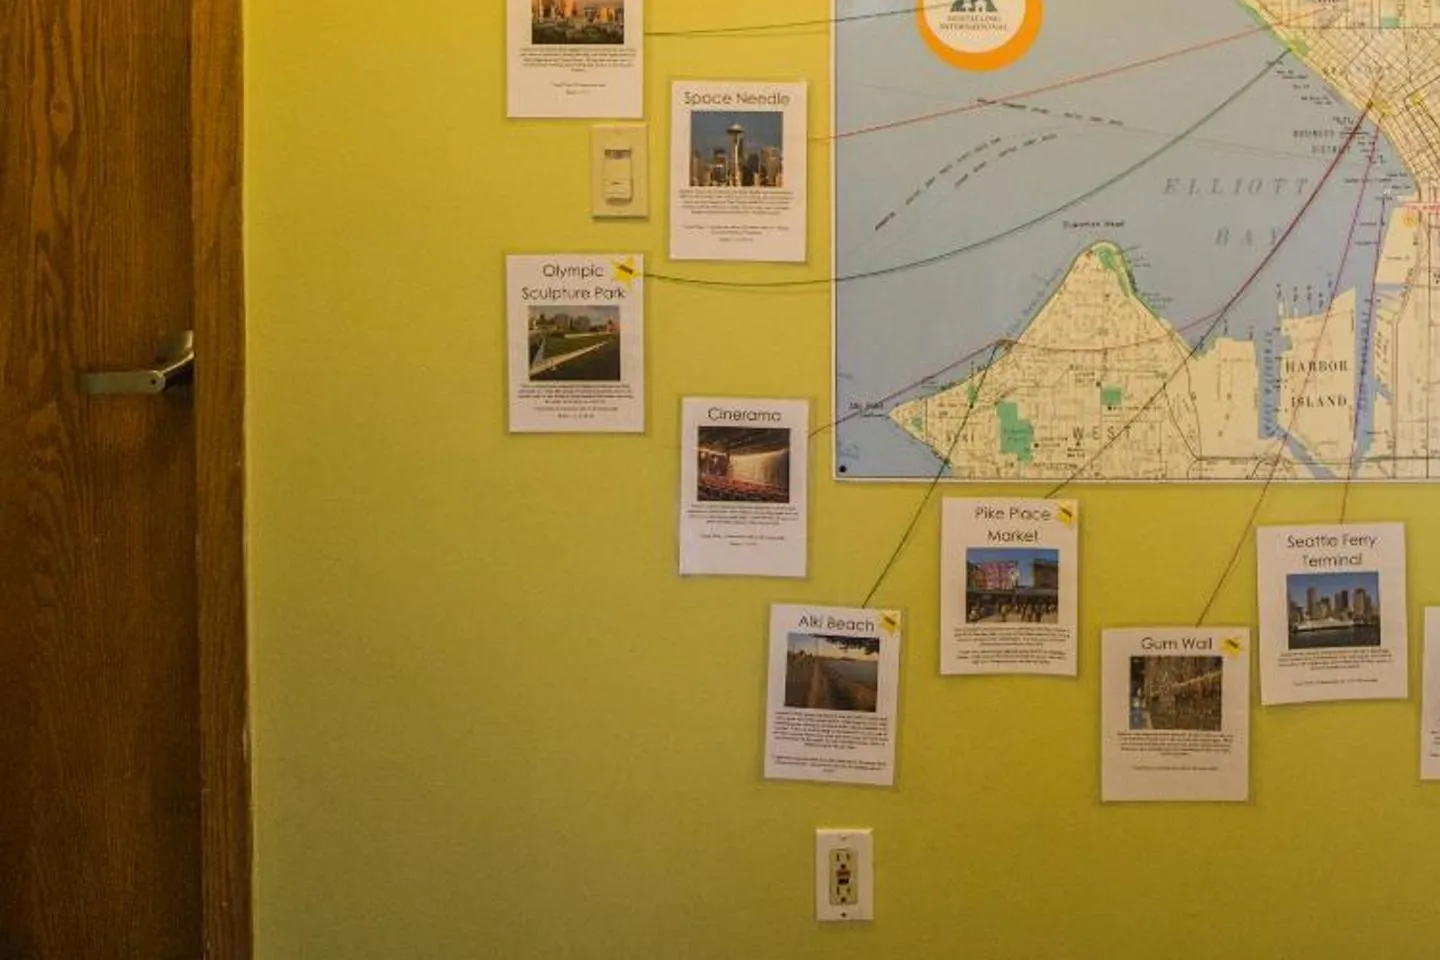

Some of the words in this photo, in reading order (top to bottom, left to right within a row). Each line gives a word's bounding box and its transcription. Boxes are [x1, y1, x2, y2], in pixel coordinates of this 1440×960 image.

[684, 92, 732, 106] Space
[736, 93, 791, 105] Needle
[1163, 177, 1309, 195] ELLIOTT
[543, 264, 604, 279] Olympic
[522, 287, 590, 301] Sculpture
[594, 287, 626, 299] Park
[1286, 361, 1348, 373] HARBOR
[1291, 394, 1347, 408] ISLAND
[708, 407, 781, 421] Cinerama
[975, 507, 1005, 520] Pike
[1010, 508, 1051, 520] Place
[988, 530, 1038, 542] Market
[1288, 535, 1338, 549] Seattle
[1342, 535, 1377, 547] Ferry
[1302, 553, 1362, 567] Terminal
[799, 616, 822, 627] Alki
[827, 617, 874, 631] Beach
[1141, 637, 1177, 650] Gum
[1182, 638, 1213, 649] Wall
